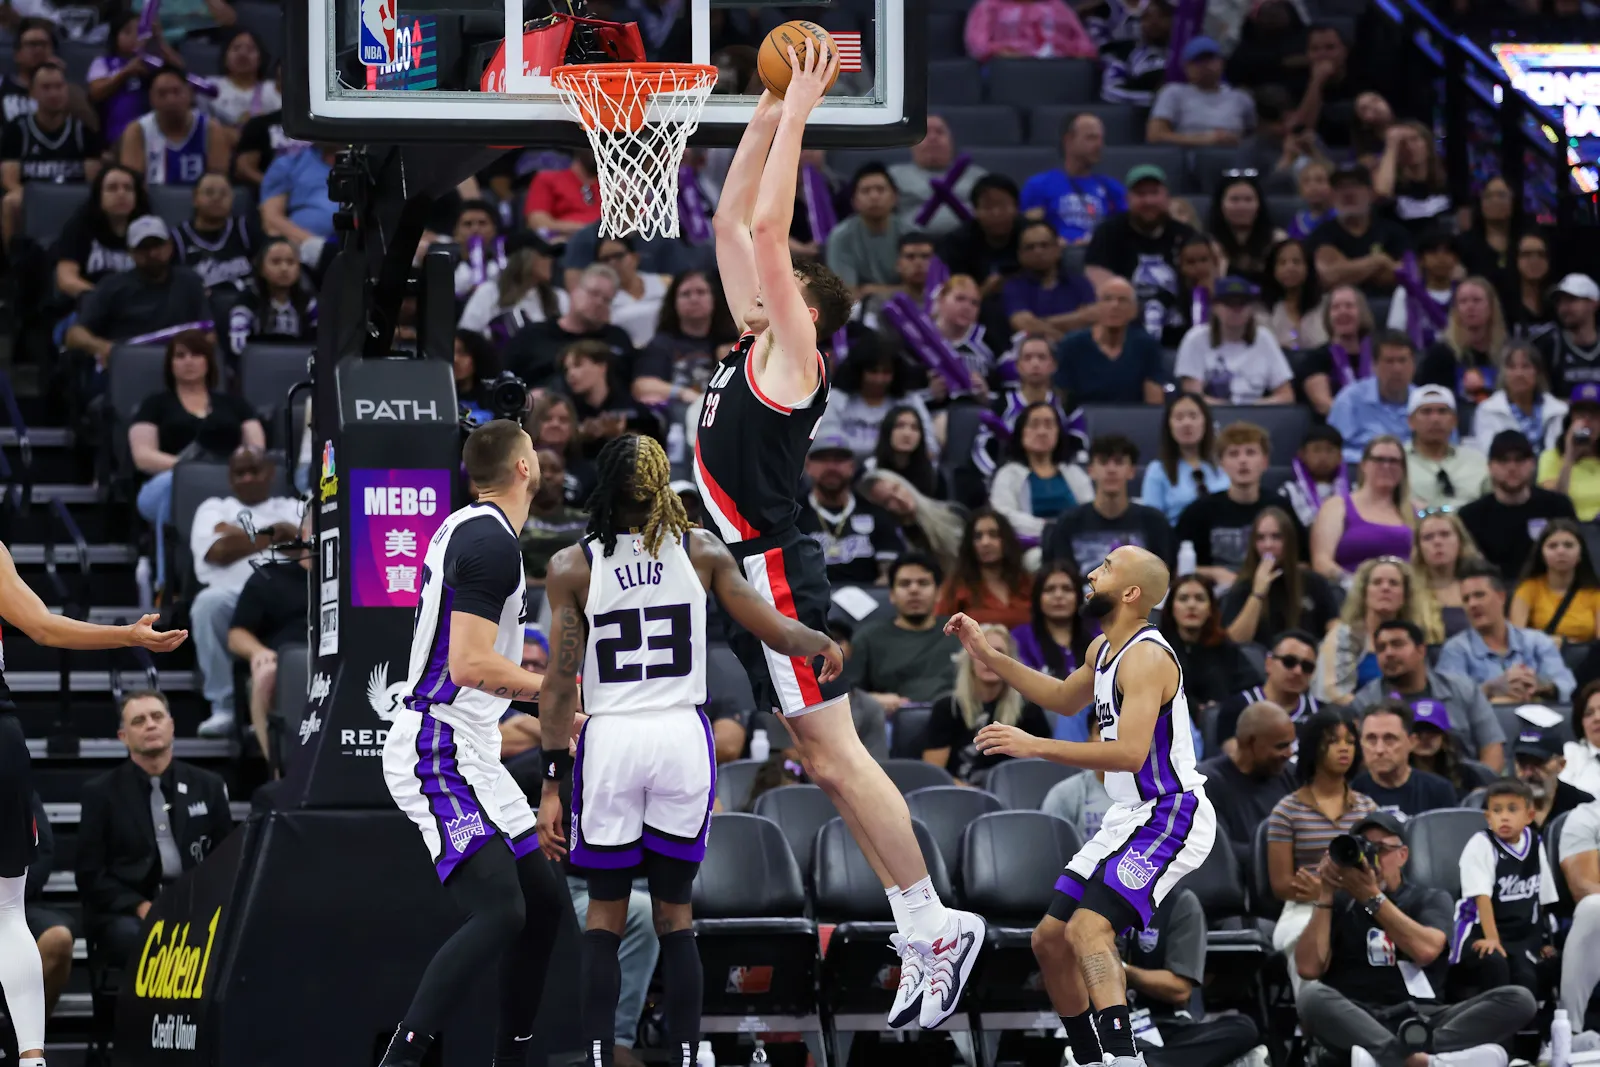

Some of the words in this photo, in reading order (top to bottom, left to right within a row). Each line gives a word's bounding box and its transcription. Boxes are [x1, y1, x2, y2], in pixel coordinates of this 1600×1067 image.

[364, 45, 382, 60] NBA
[701, 392, 720, 428] 23
[363, 486, 437, 516] MEBO
[384, 528, 418, 594] 美寶
[614, 561, 664, 591] ELLIS
[593, 602, 692, 684] 23
[355, 749, 384, 757] RESO
[1120, 859, 1149, 884] KINGS
[136, 920, 201, 999] Golden
[192, 905, 222, 999] 1
[152, 1013, 175, 1049] Credit
[175, 1014, 197, 1050] Union
